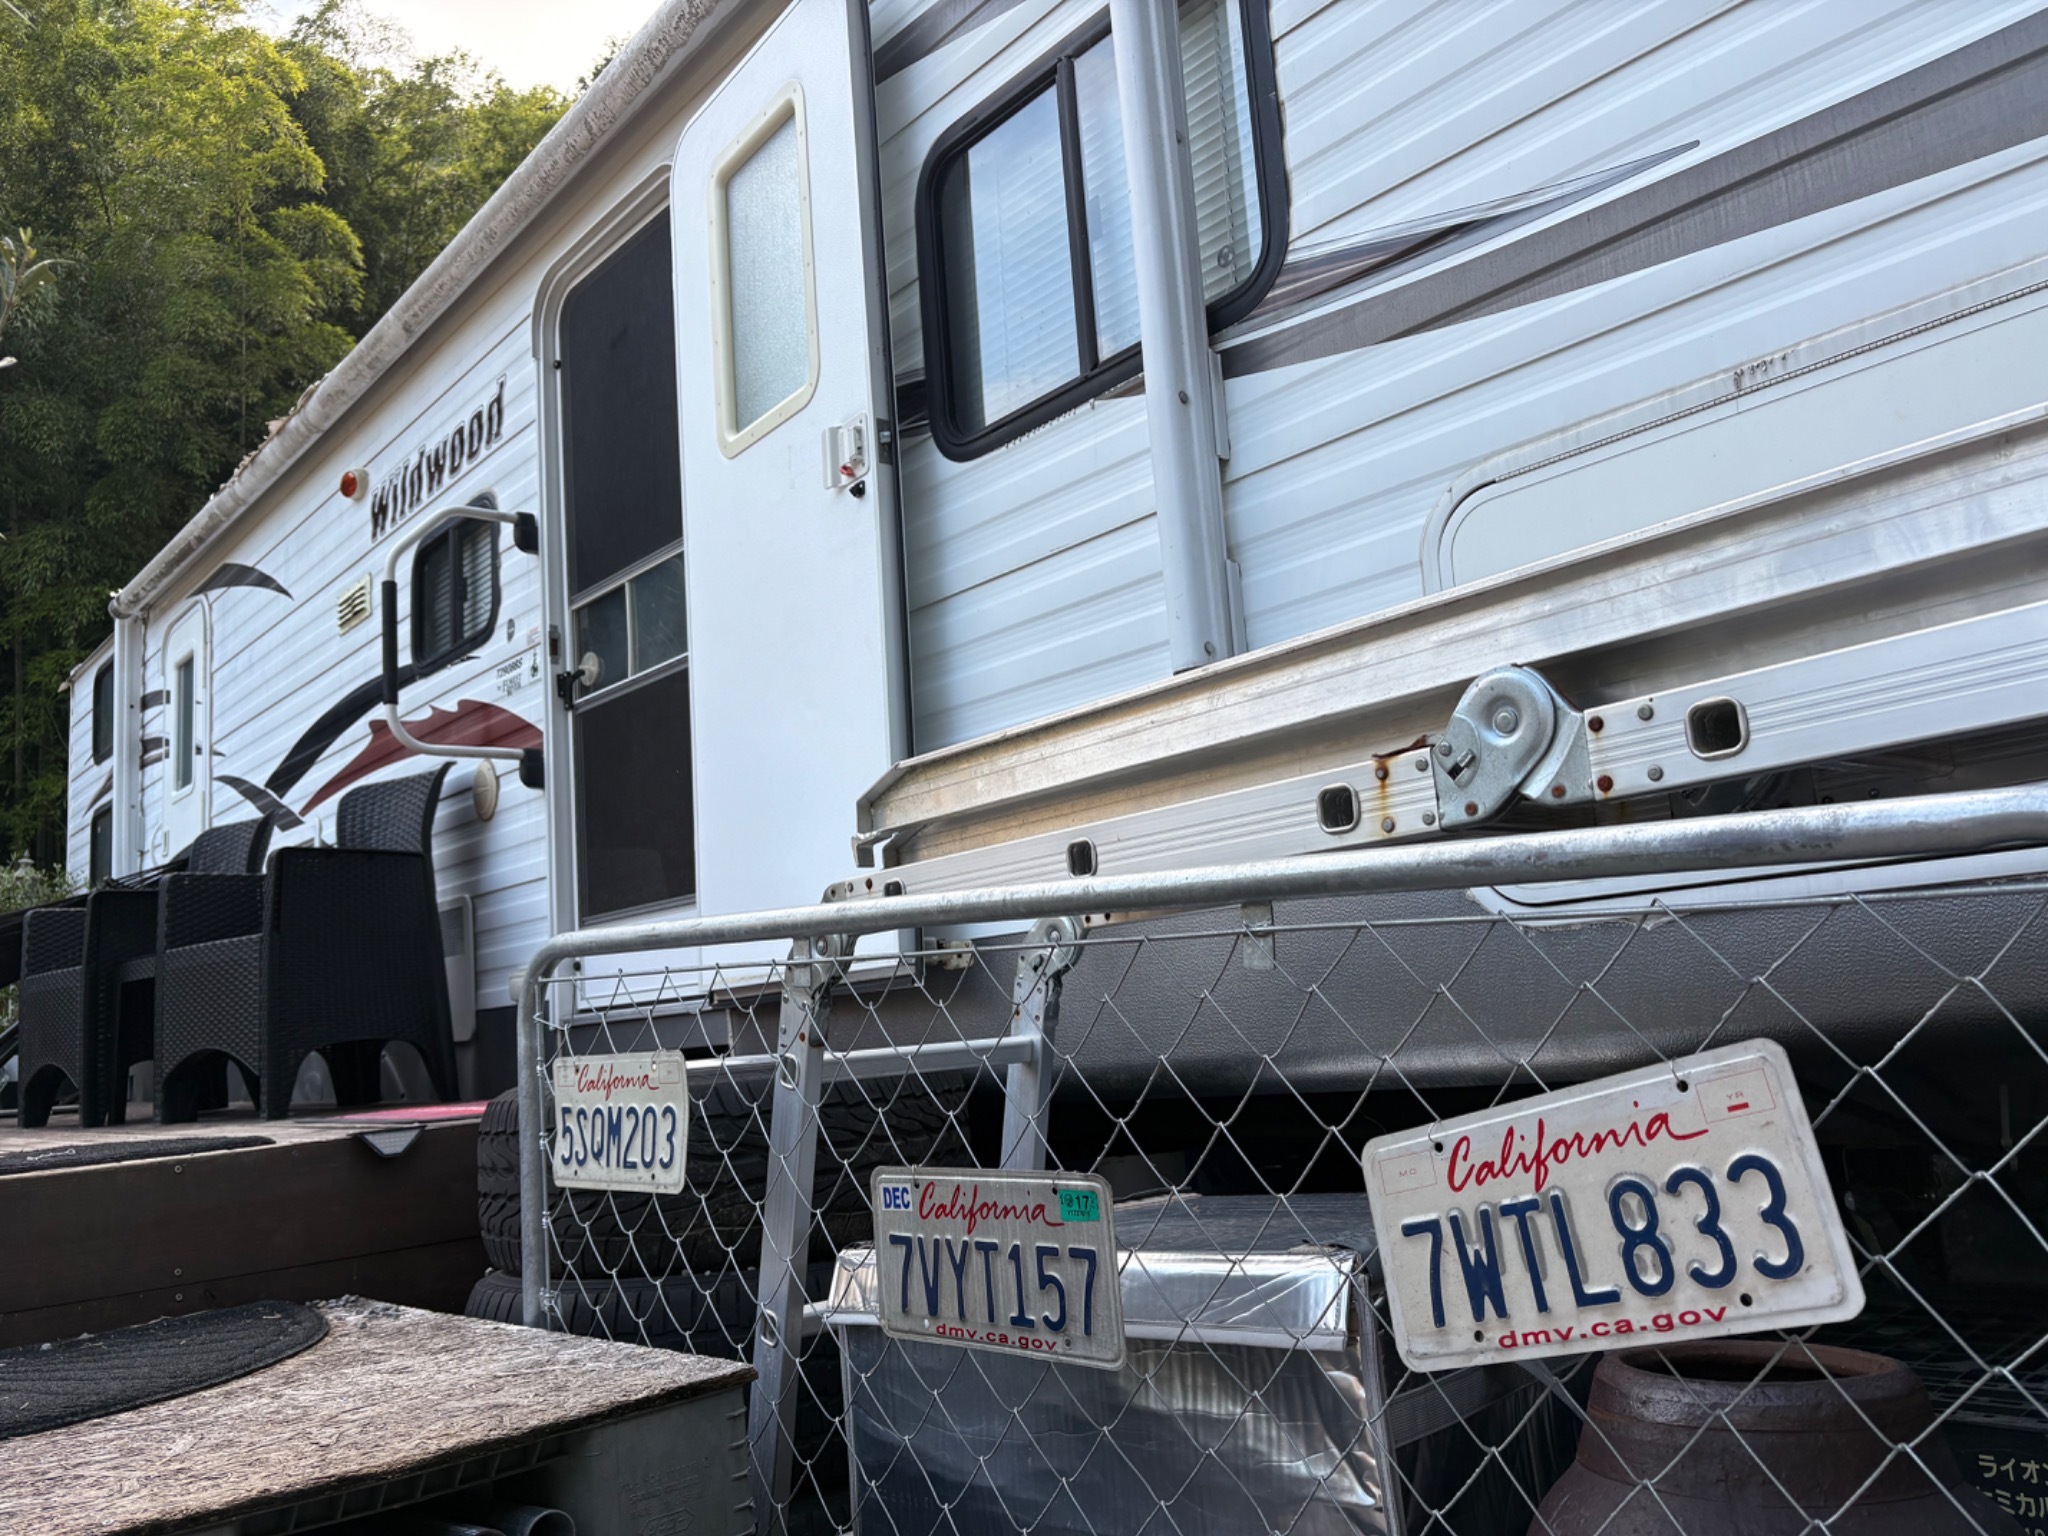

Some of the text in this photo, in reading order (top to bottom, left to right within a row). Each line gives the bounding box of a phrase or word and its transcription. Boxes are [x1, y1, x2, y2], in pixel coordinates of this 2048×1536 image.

[371, 376, 506, 541] Wildwood
[578, 1063, 660, 1101] California
[561, 1105, 677, 1169] 5SQM203
[1446, 1100, 1709, 1193] California
[883, 1186, 911, 1210] DEC
[919, 1181, 1065, 1235] California
[1074, 1194, 1090, 1211] 17
[1401, 1153, 1805, 1328] 7WTL833
[889, 1233, 1098, 1336] 7VYT157
[936, 1323, 1058, 1350] dmv.ca.gov
[1498, 1305, 1728, 1349] dmv.ca.gov
